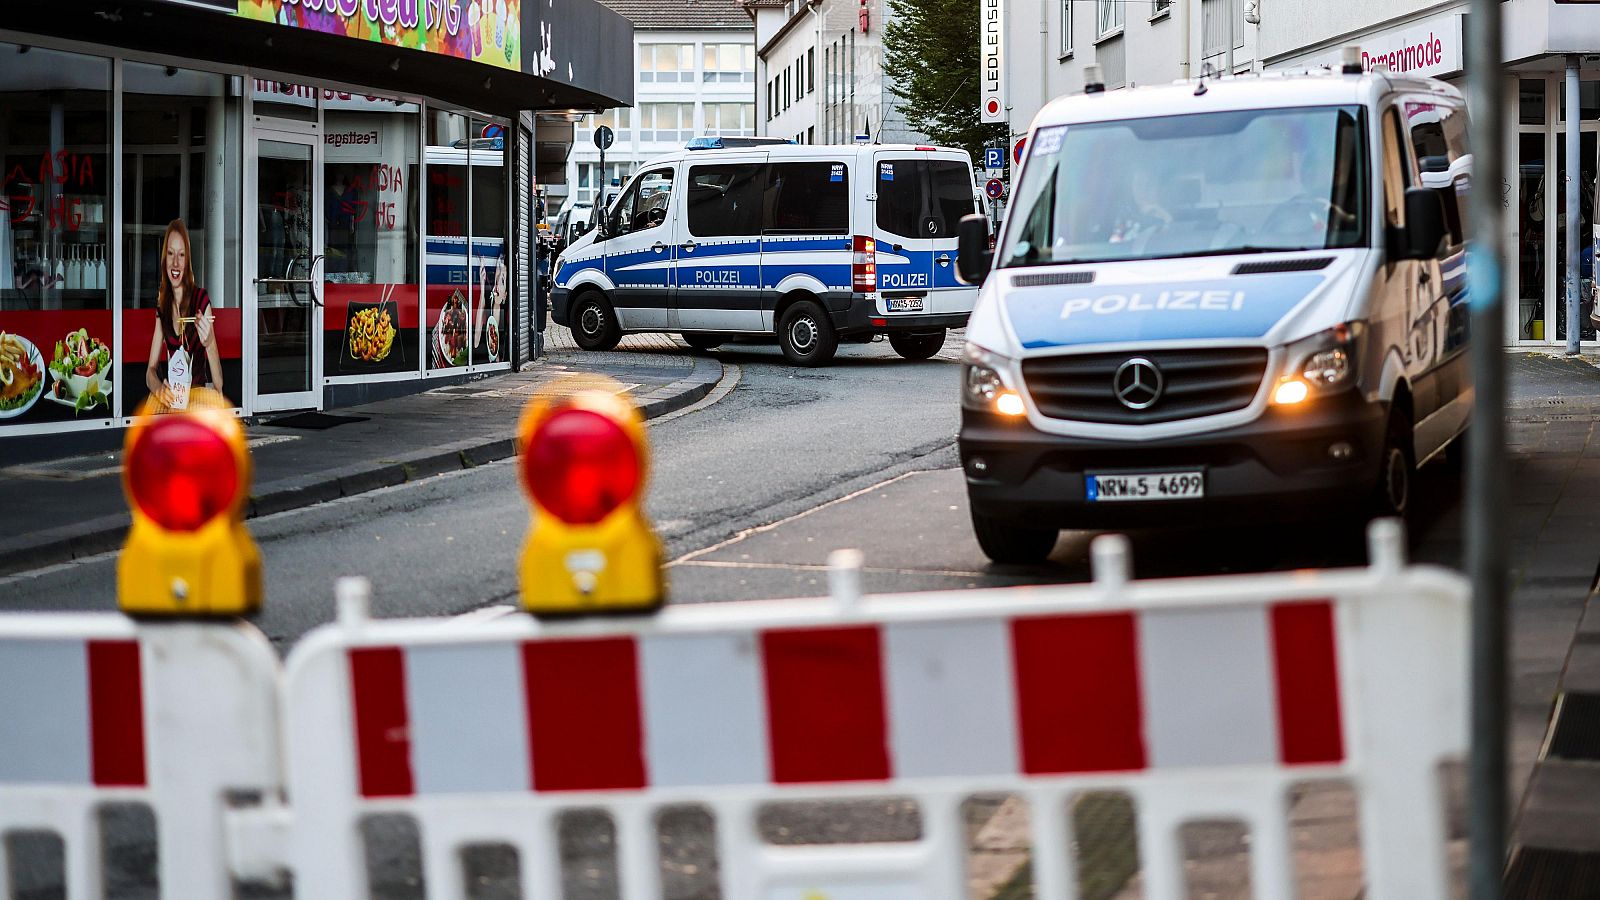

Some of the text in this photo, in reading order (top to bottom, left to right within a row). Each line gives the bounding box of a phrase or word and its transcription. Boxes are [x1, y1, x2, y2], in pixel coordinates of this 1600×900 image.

[39, 149, 94, 187] ASIA
[695, 270, 740, 283] POLIZEI
[882, 273, 928, 287] POLIZEI
[1060, 291, 1246, 320] POLIZEI
